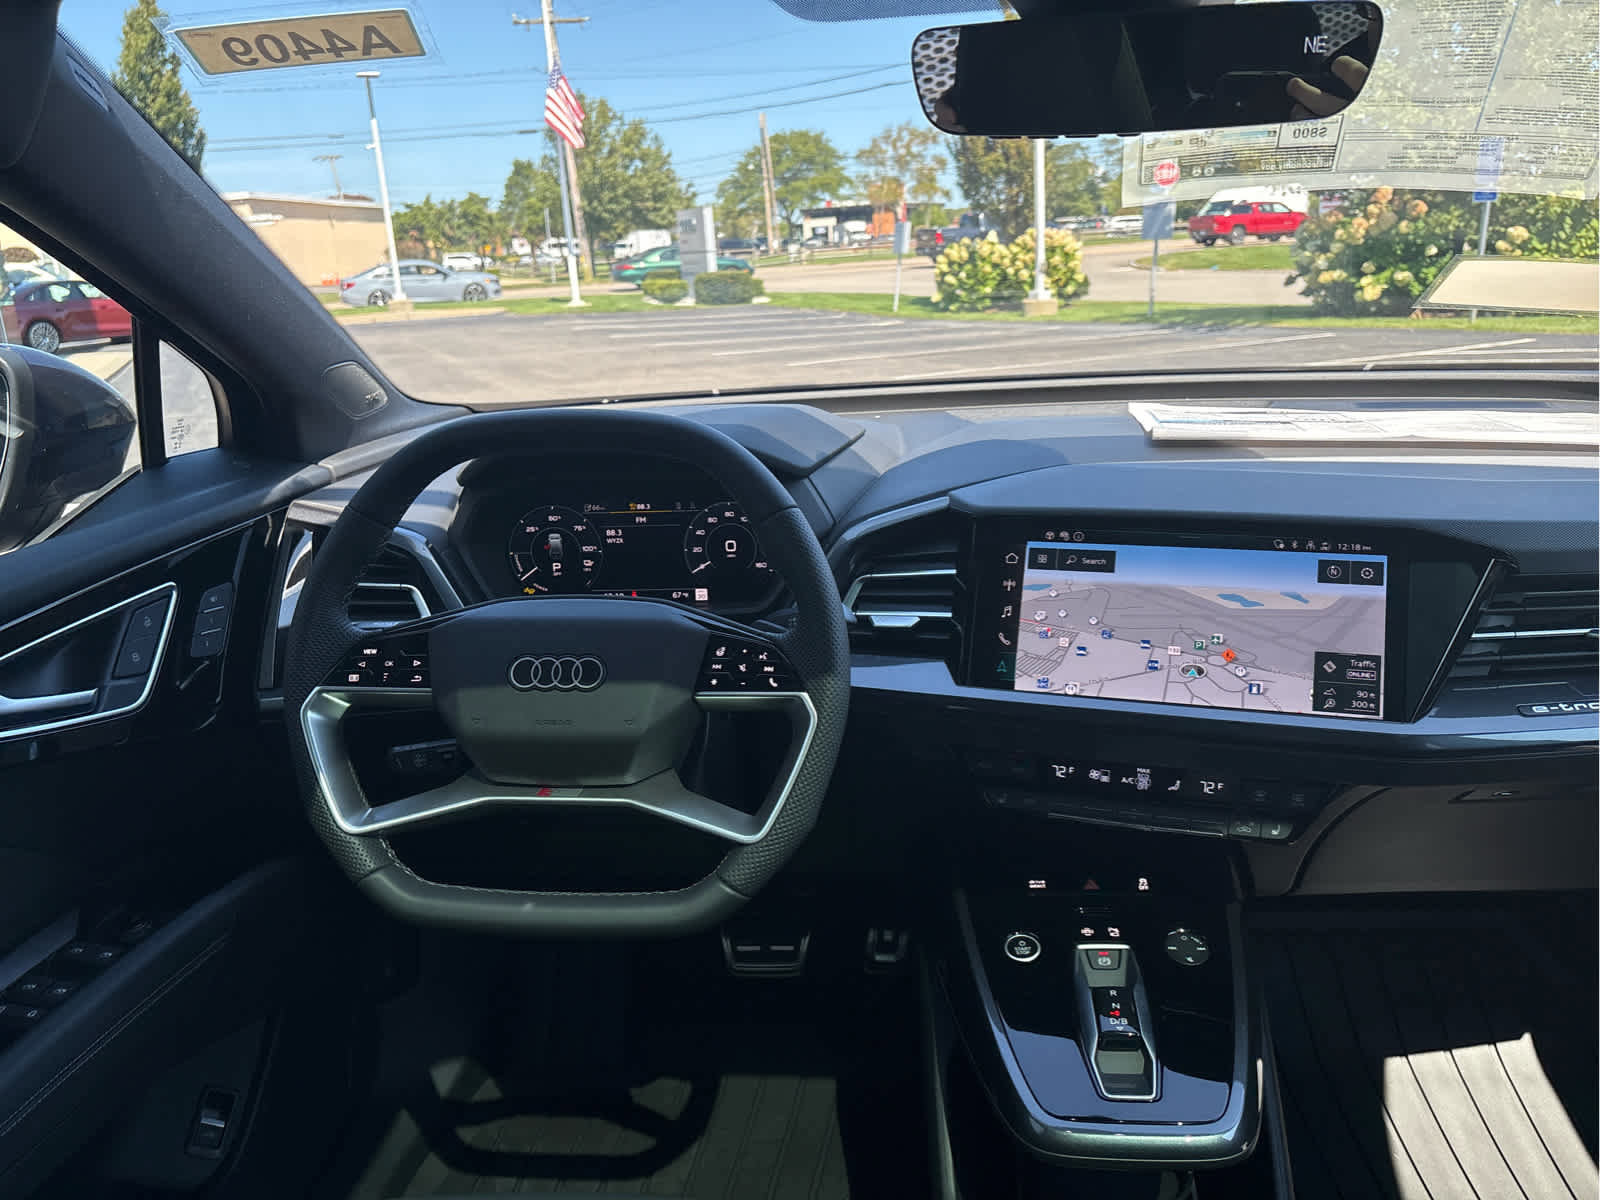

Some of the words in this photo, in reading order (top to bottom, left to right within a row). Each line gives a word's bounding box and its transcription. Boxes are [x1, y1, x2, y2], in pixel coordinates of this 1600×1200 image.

[1303, 35, 1329, 54] NE
[1337, 543, 1361, 551] 12:18
[1081, 556, 1107, 565] Search
[552, 562, 562, 572] P
[672, 591, 682, 599] 67
[1351, 659, 1377, 669] Traffic
[1356, 690, 1368, 699] 90
[1351, 700, 1368, 708] 300
[1051, 764, 1066, 778] 72
[1200, 780, 1215, 794] 72
[1109, 989, 1118, 997] R
